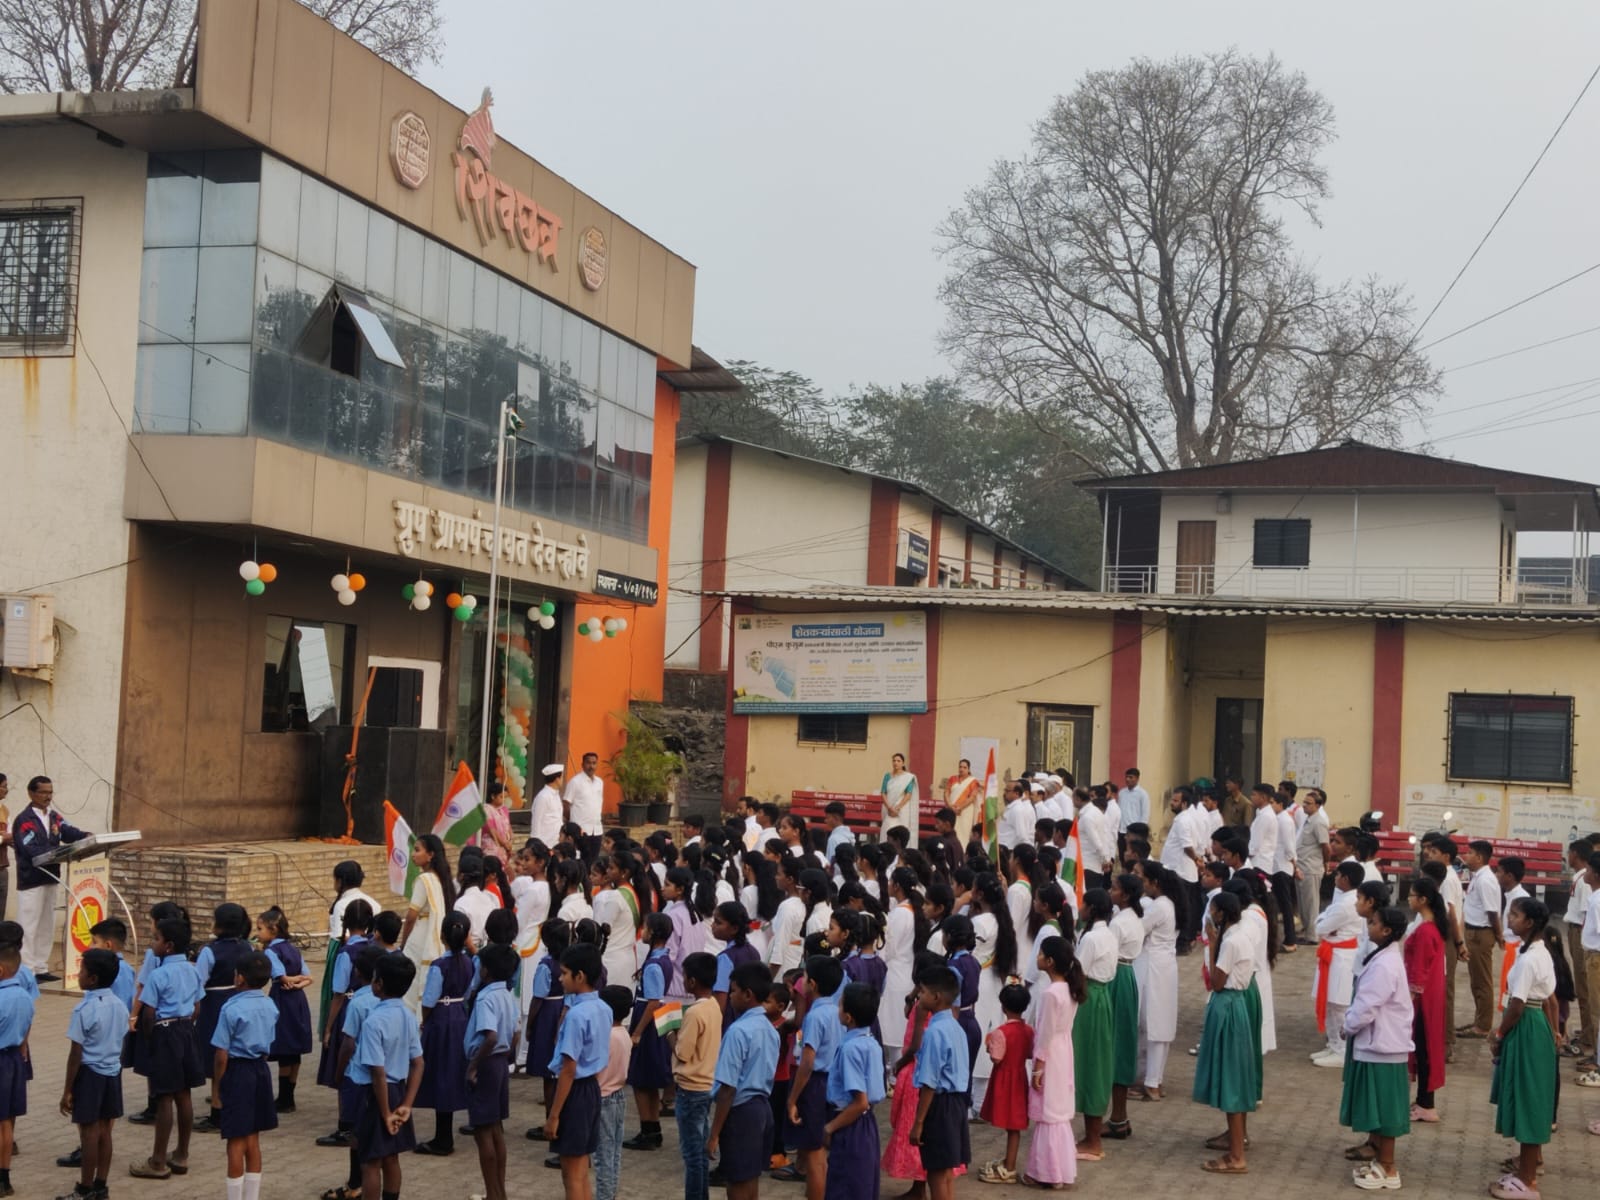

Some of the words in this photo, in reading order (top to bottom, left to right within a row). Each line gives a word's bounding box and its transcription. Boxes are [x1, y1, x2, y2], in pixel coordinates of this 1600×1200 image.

[451, 151, 563, 273] शिवछत्र
[392, 499, 428, 556] ग्रुप
[430, 508, 530, 567] ग्रामपंचायत
[530, 520, 590, 580] देवन्हावे
[795, 625, 851, 637] शेतकऱ्यांसाठी
[853, 625, 881, 636] योजना
